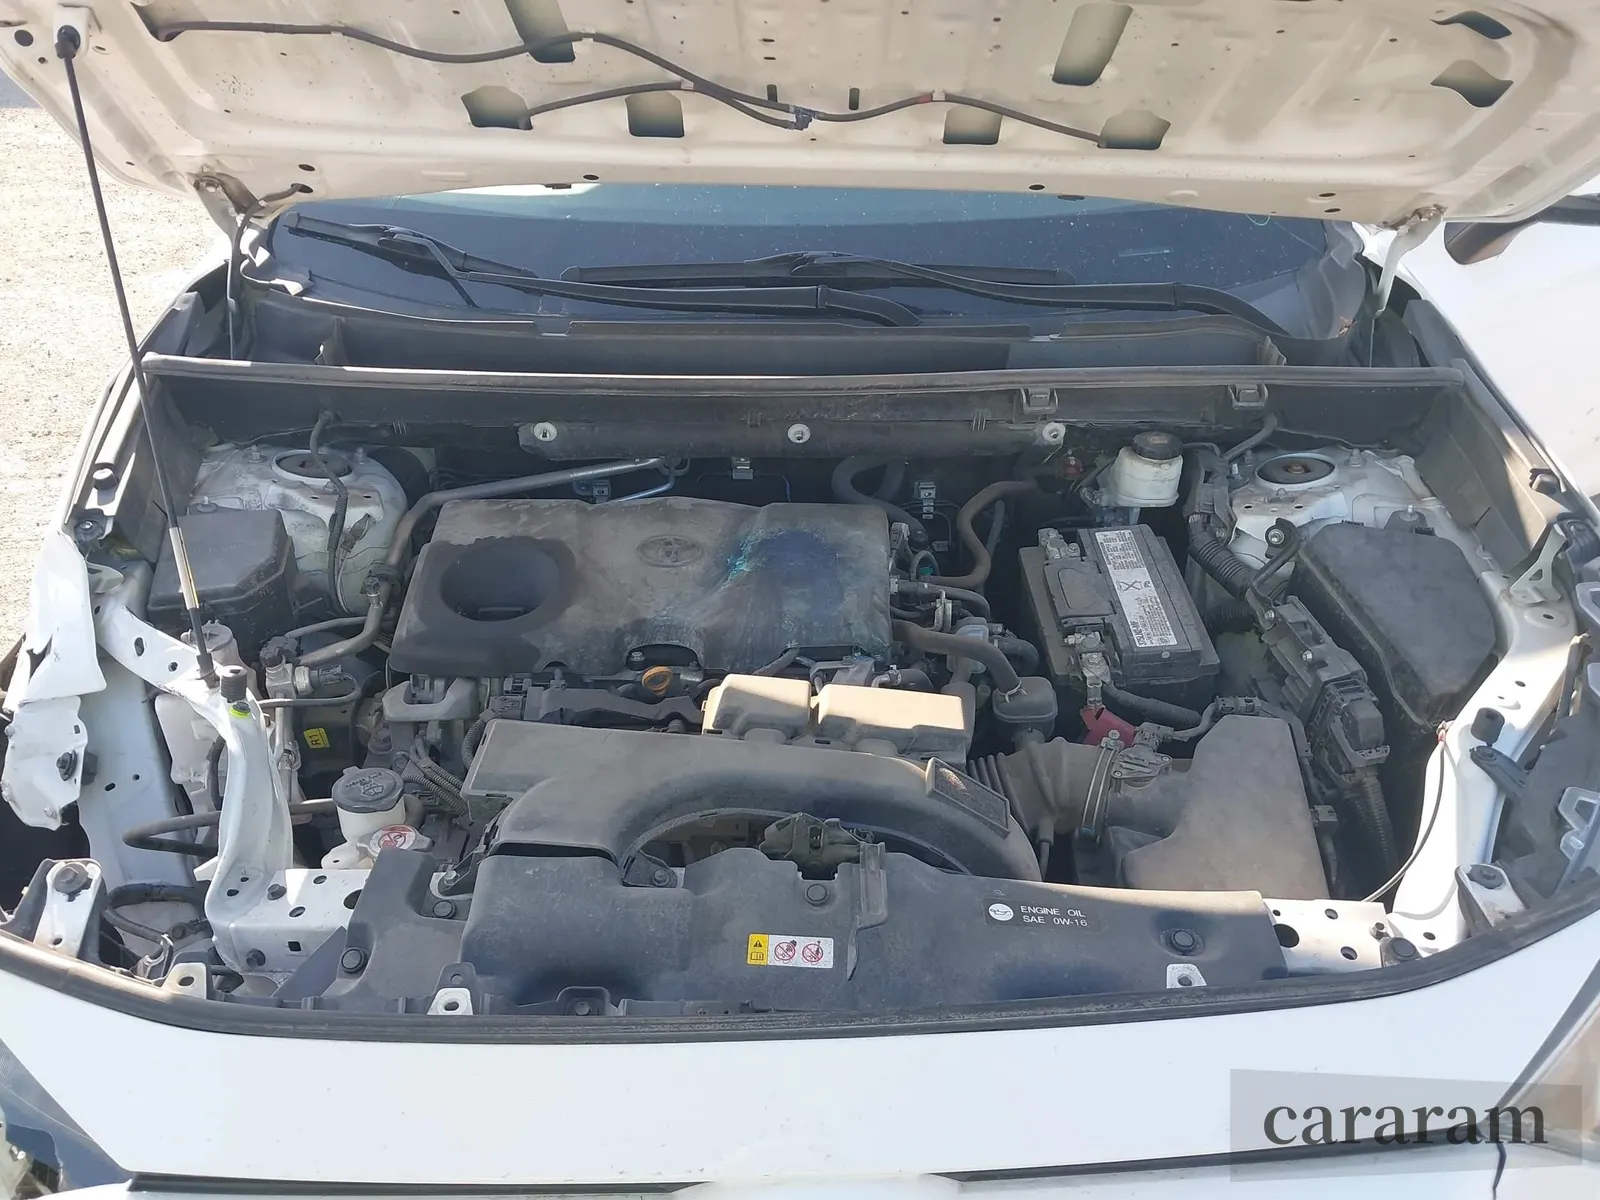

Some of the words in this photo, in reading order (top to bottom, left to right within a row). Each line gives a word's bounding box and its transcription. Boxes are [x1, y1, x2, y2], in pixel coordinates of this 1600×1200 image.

[308, 733, 322, 746] R1
[1020, 905, 1060, 916] ENGINE
[1067, 909, 1086, 918] OIL
[1022, 915, 1046, 924] SAE
[1053, 917, 1088, 927] 0W-16
